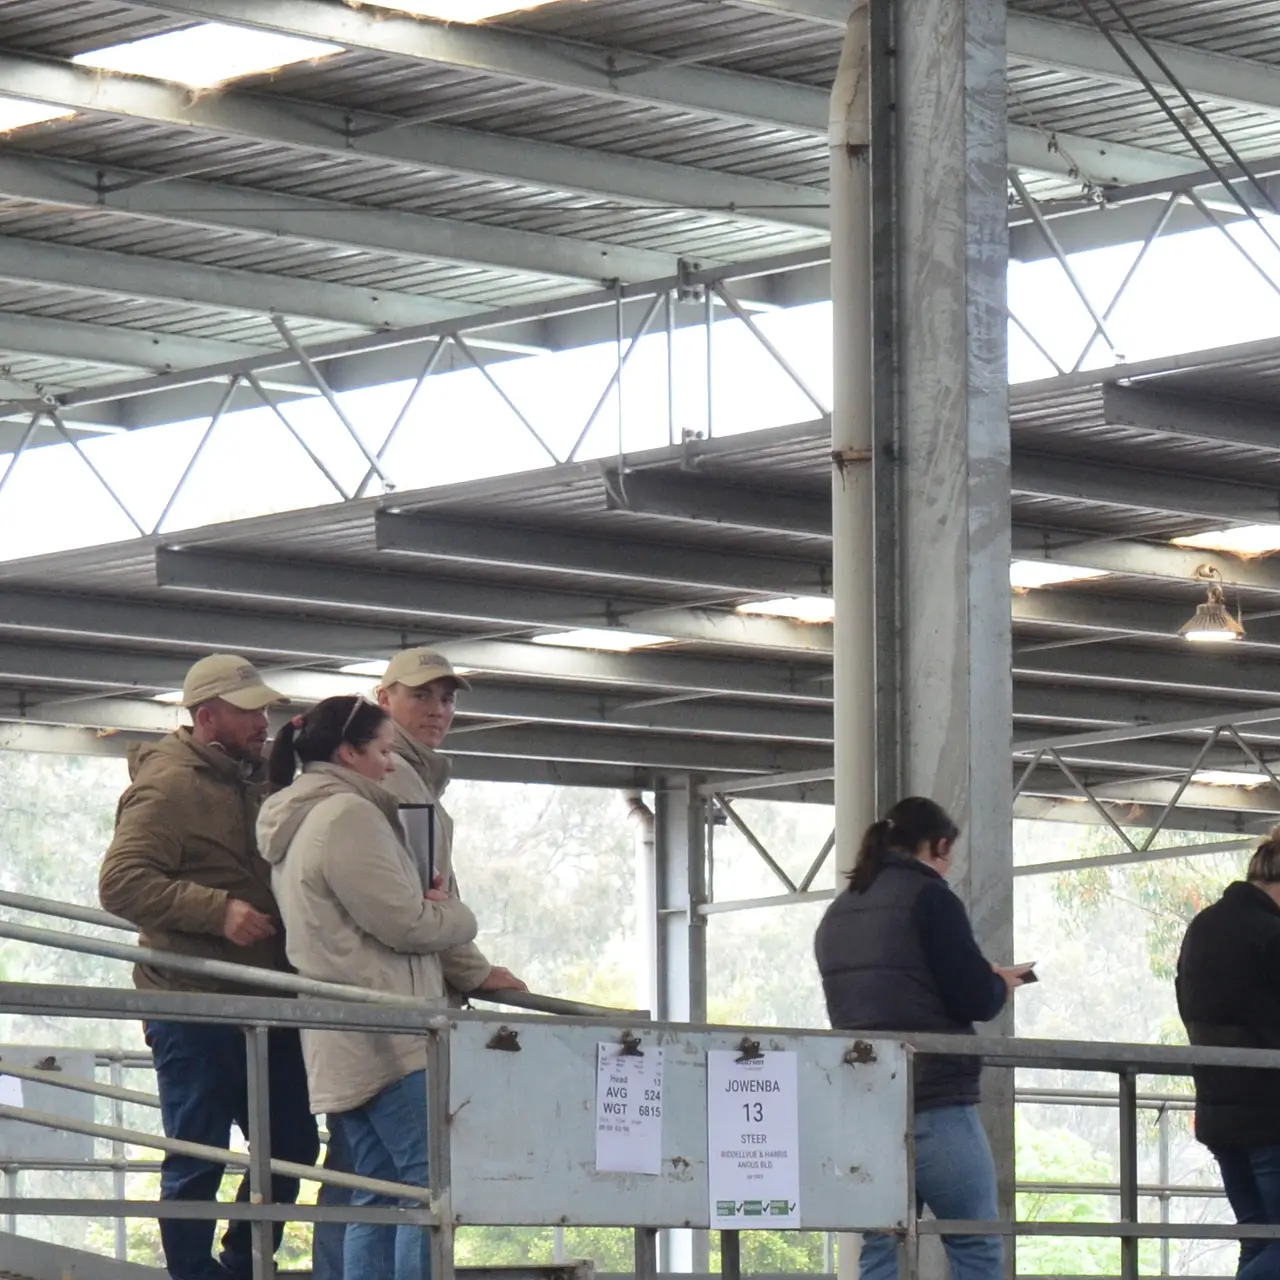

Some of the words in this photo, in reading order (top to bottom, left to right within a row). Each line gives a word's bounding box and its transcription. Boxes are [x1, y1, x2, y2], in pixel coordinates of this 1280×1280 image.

[725, 1080, 780, 1092] JOWENBA
[606, 1087, 627, 1098] AVG
[644, 1090, 660, 1101] 524
[603, 1103, 627, 1114] WGT
[639, 1105, 661, 1117] 6815
[743, 1102, 763, 1122] 13
[741, 1134, 767, 1144] STEER
